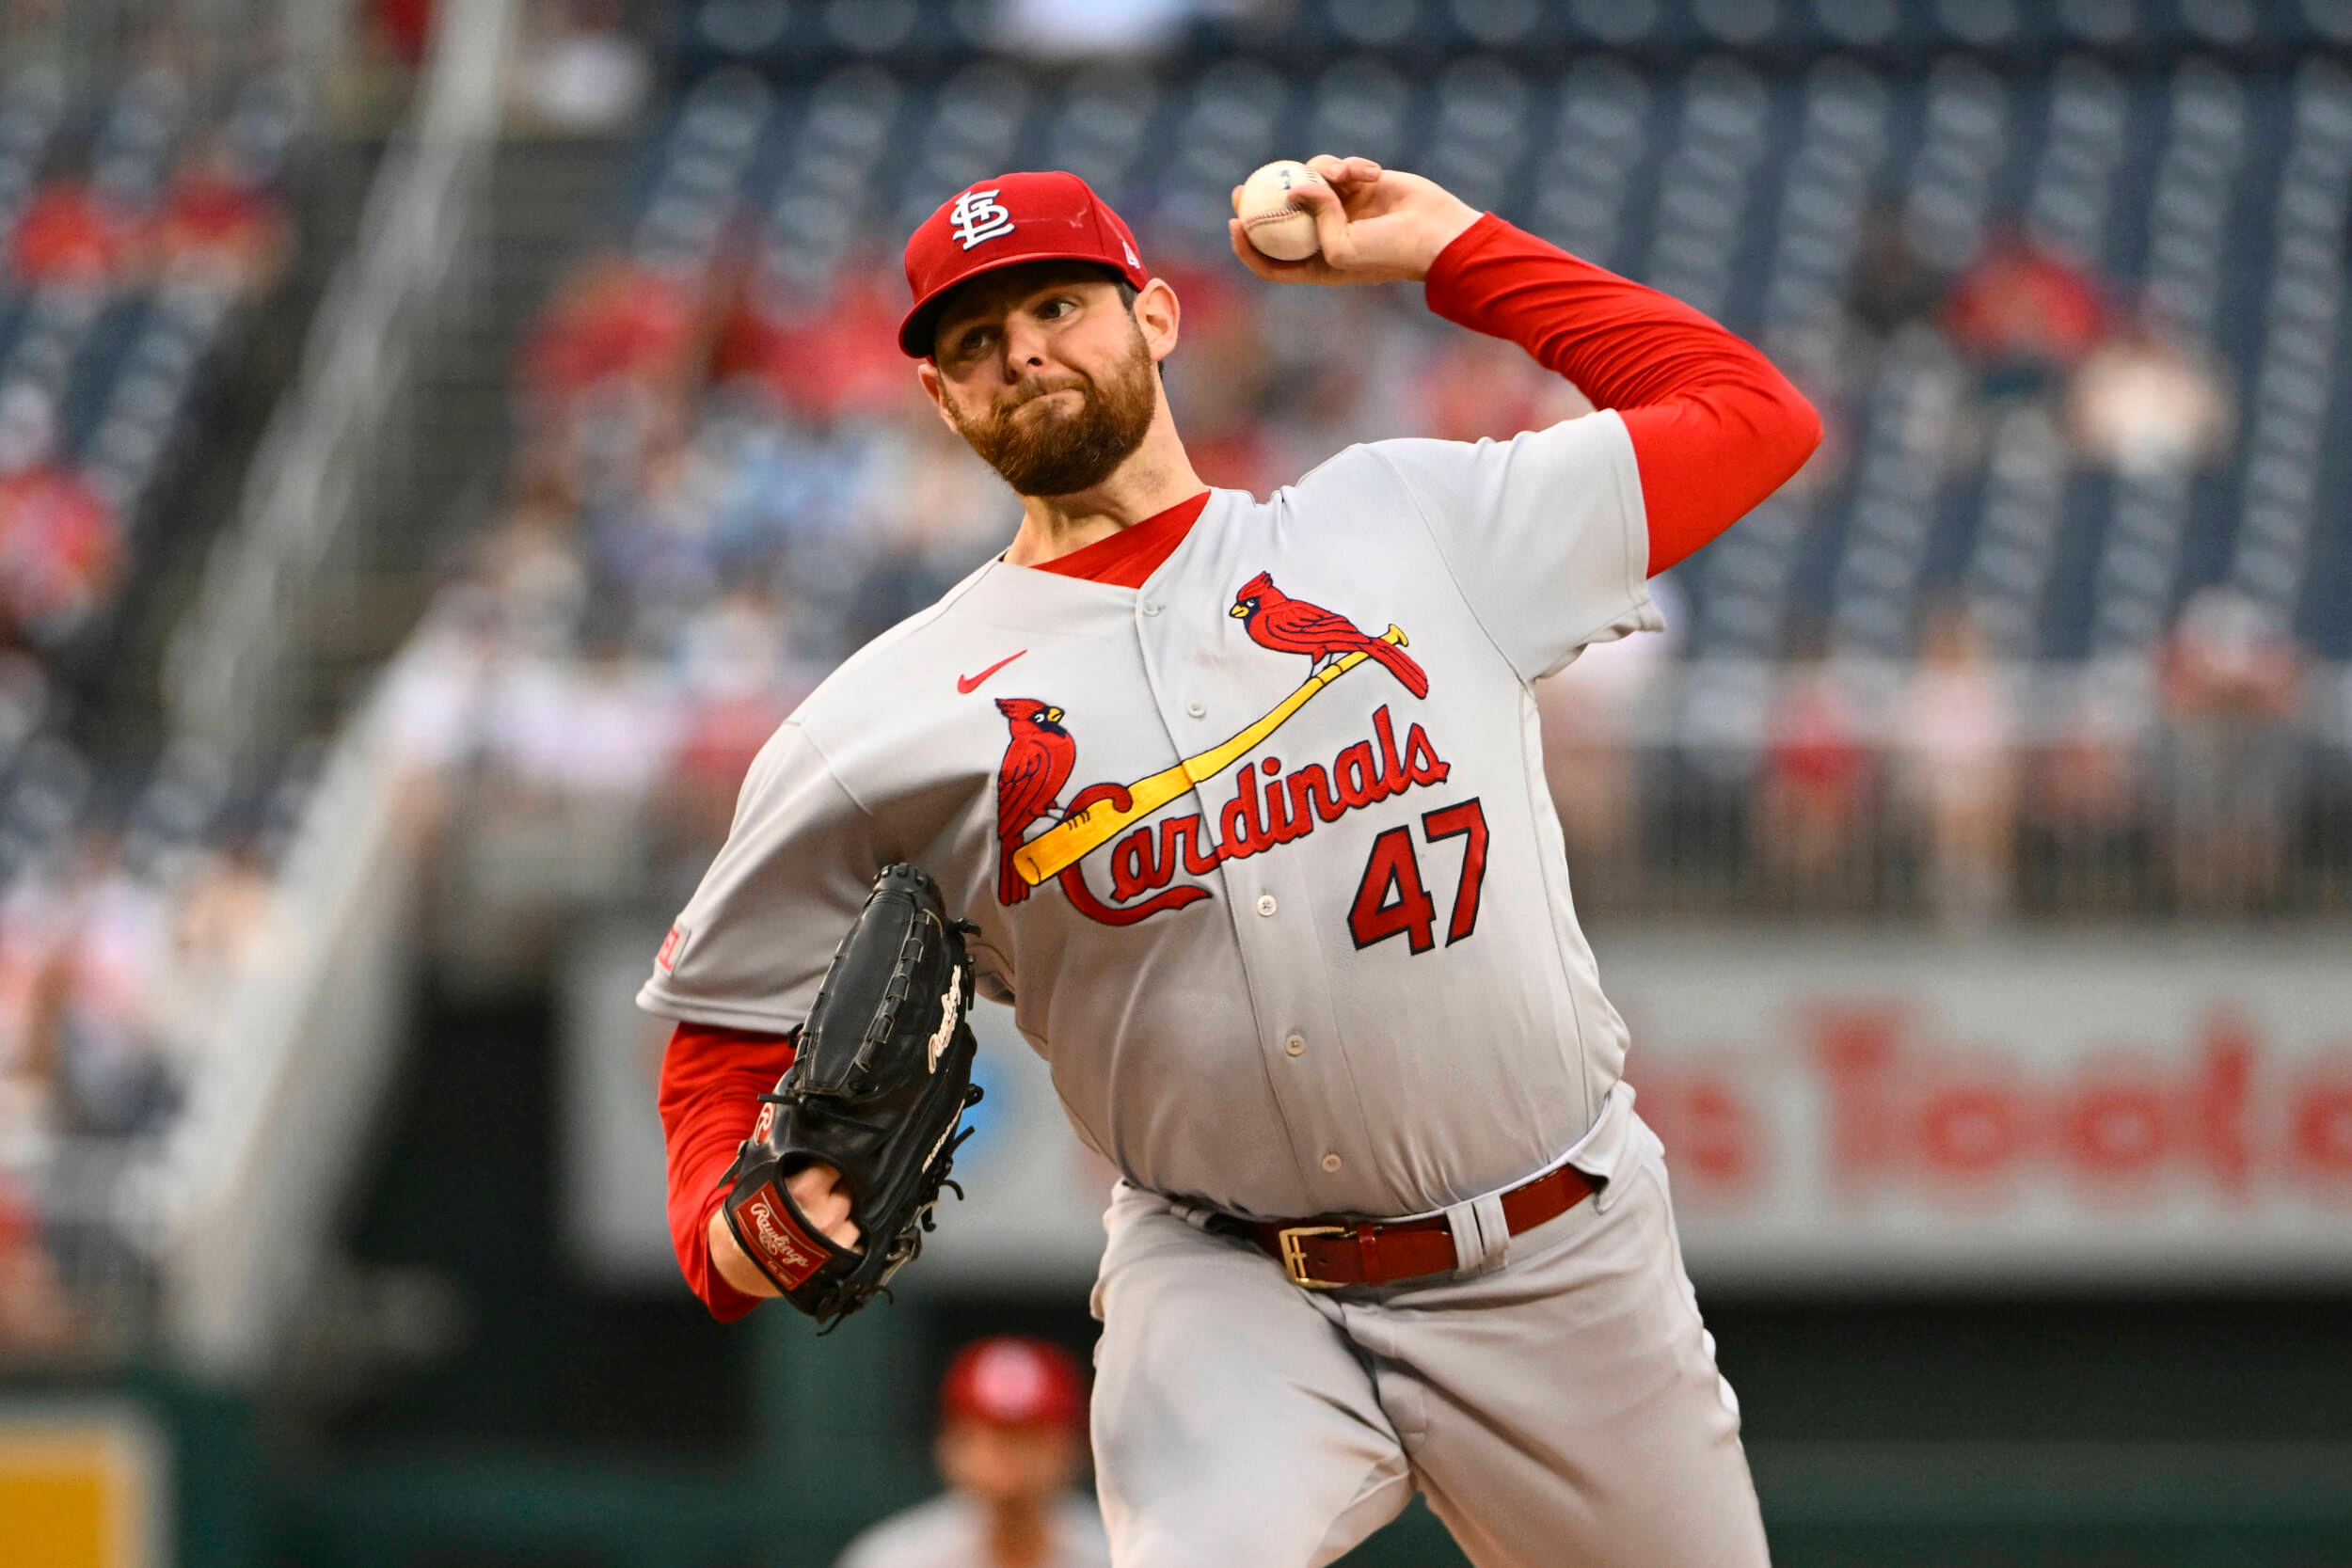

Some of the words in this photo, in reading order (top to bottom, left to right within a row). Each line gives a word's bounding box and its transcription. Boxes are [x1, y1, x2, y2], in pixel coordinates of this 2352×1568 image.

[1059, 705, 1451, 927] Cardinals
[1346, 797, 1490, 956] 47
[750, 1202, 809, 1268] Rawlings
